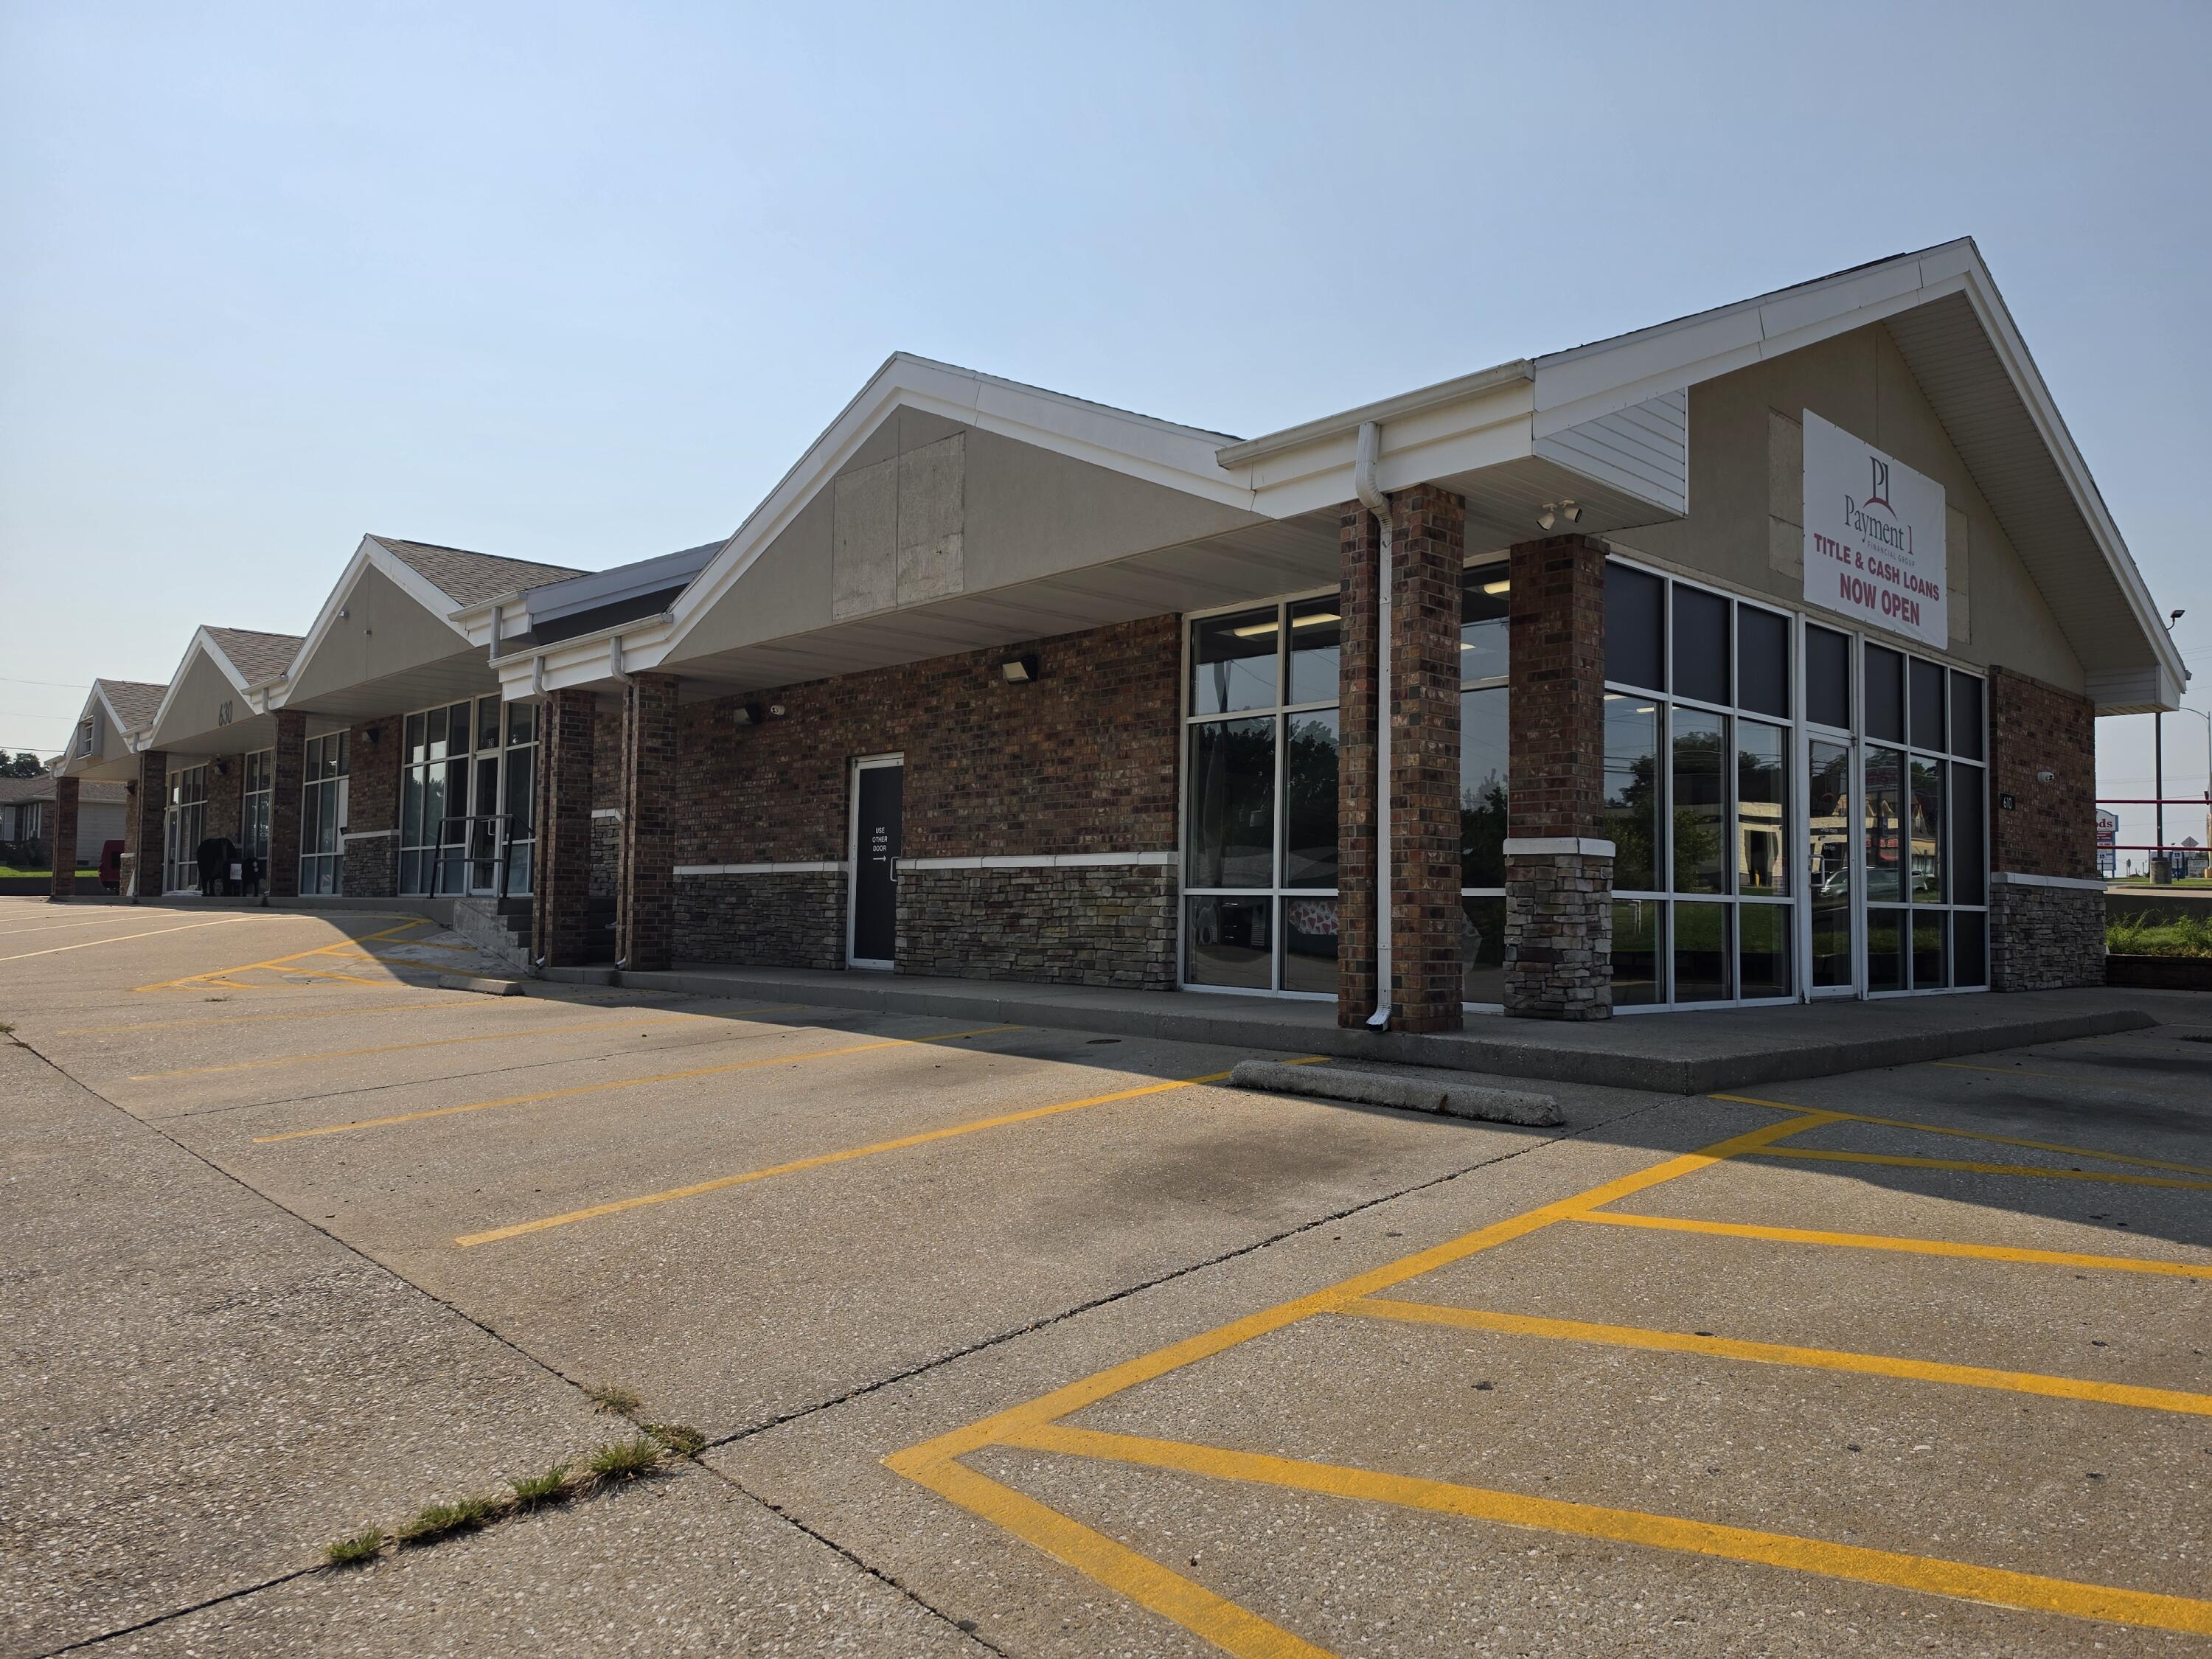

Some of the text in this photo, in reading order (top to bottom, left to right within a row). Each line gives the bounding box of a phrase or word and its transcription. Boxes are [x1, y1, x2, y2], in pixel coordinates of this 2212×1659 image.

[1844, 494, 1914, 555] Payment 1
[1814, 532, 1940, 602] TITLE & CASH LOANS
[1868, 540, 1915, 567] FINANCIAL GROUP
[1840, 572, 1920, 627] NOW OPEN
[218, 700, 233, 726] 630
[2003, 796, 2012, 810] 610
